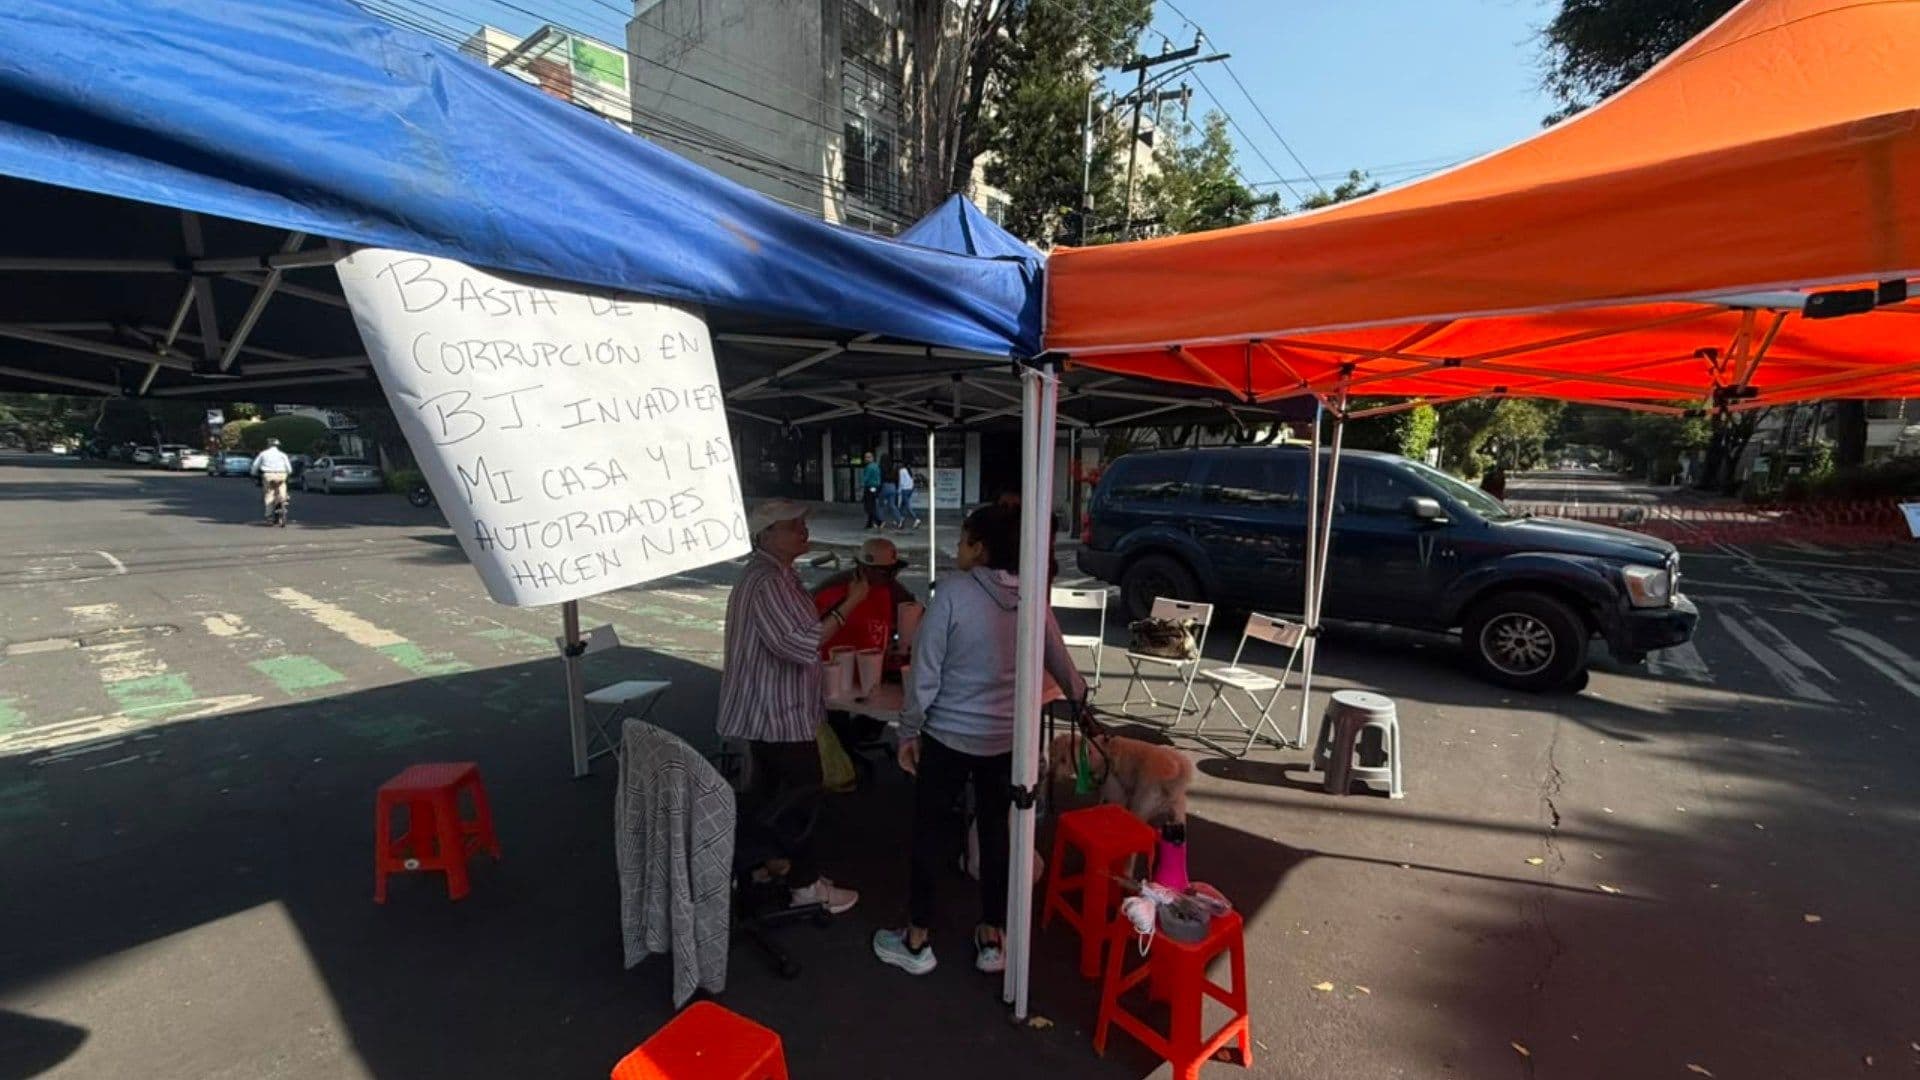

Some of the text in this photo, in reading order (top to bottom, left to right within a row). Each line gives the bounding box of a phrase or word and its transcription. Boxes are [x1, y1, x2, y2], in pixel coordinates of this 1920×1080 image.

[375, 258, 559, 317] BASTA
[411, 331, 700, 375] CORRUPCIÓN EN
[456, 435, 731, 505] MI CASA Y LAS
[473, 487, 705, 552] AUTORIDADES
[510, 547, 623, 590] HACEN
